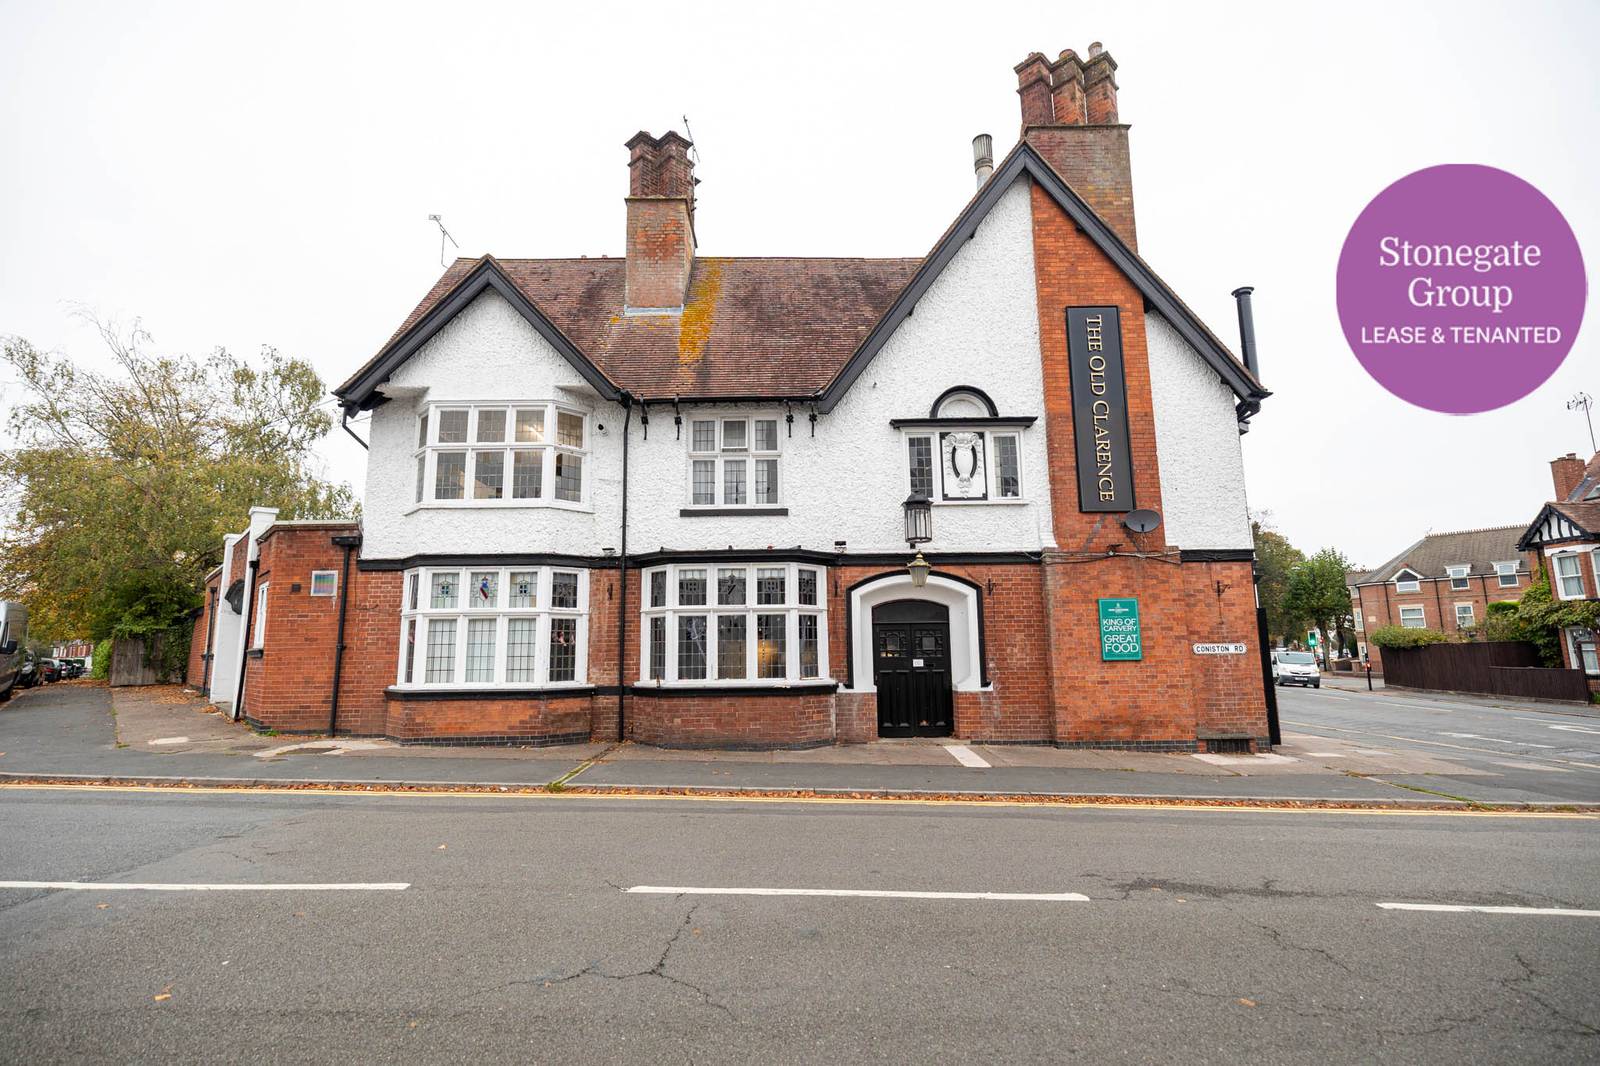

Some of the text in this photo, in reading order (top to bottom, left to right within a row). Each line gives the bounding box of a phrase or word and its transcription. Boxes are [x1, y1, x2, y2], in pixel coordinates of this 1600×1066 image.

[1086, 314, 1115, 502] THE OLD CLARENCE
[1104, 634, 1138, 643] GREAT
[1105, 643, 1139, 653] FOOD
